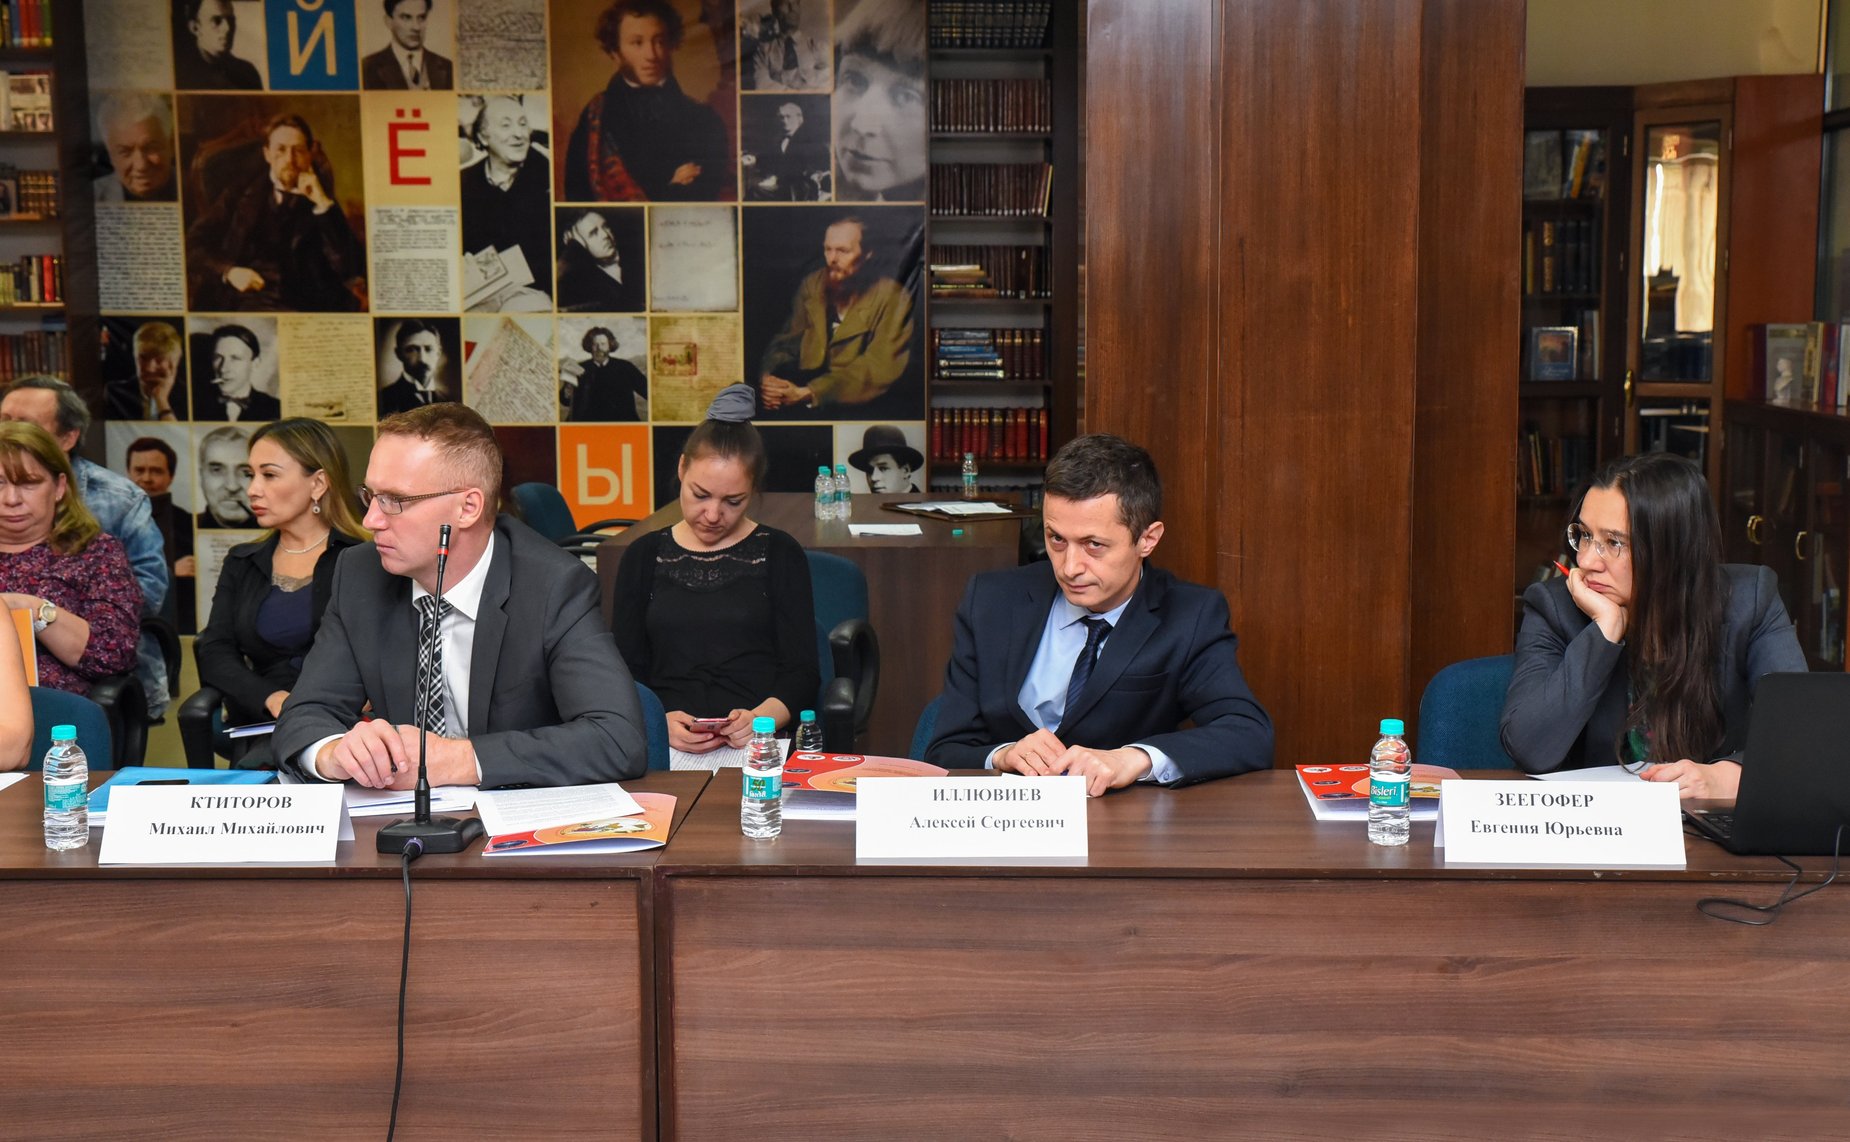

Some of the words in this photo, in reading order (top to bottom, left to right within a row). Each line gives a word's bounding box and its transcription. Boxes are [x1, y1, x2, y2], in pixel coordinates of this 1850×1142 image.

[387, 108, 432, 186] Ё
[576, 443, 634, 505] Ы
[933, 788, 1042, 802] ИЛЛЮВИЕВ
[1371, 785, 1396, 796] Bisleri
[190, 796, 292, 809] КТИТОРОВ
[1495, 793, 1594, 808] ЗЕЕГОФЕР
[149, 821, 216, 836] Михаил
[220, 819, 326, 836] Михайлович
[910, 816, 975, 828] Алексей
[980, 815, 1066, 832] Сергеевич
[1470, 819, 1540, 835] Евгения
[1545, 821, 1623, 840] Юрьевна
